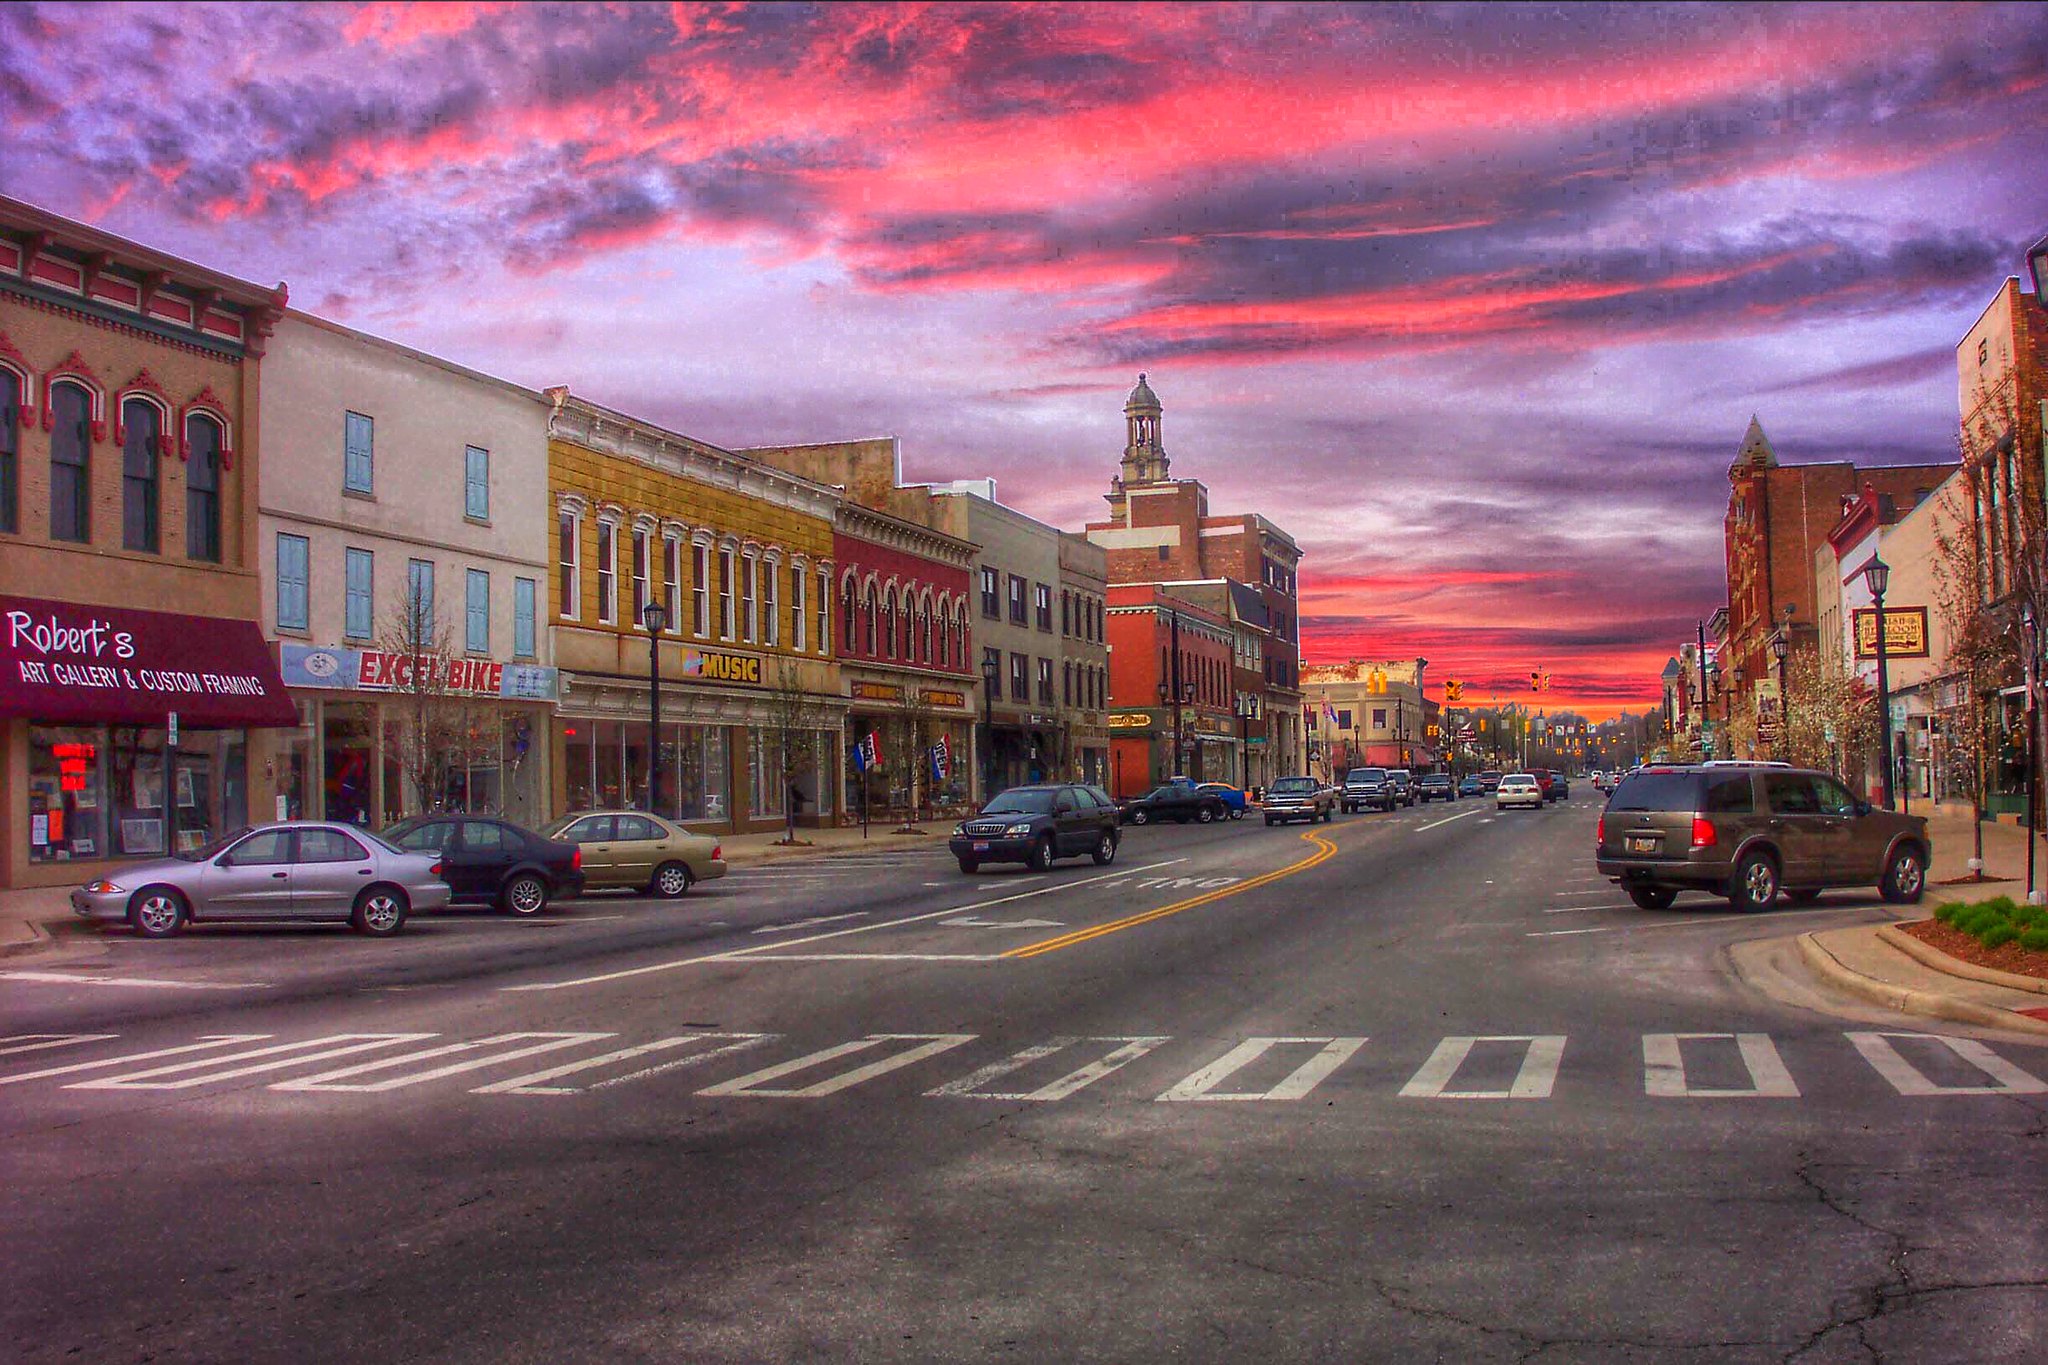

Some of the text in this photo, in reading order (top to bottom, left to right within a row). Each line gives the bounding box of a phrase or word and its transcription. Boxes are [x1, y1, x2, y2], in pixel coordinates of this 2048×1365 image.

[7, 610, 136, 659] Robert's
[19, 660, 266, 697] ART GALLERY & CUSTOM FRAMING
[359, 651, 443, 689] EXCEL
[447, 658, 503, 692] BIKE
[702, 653, 758, 683] MUSIC
